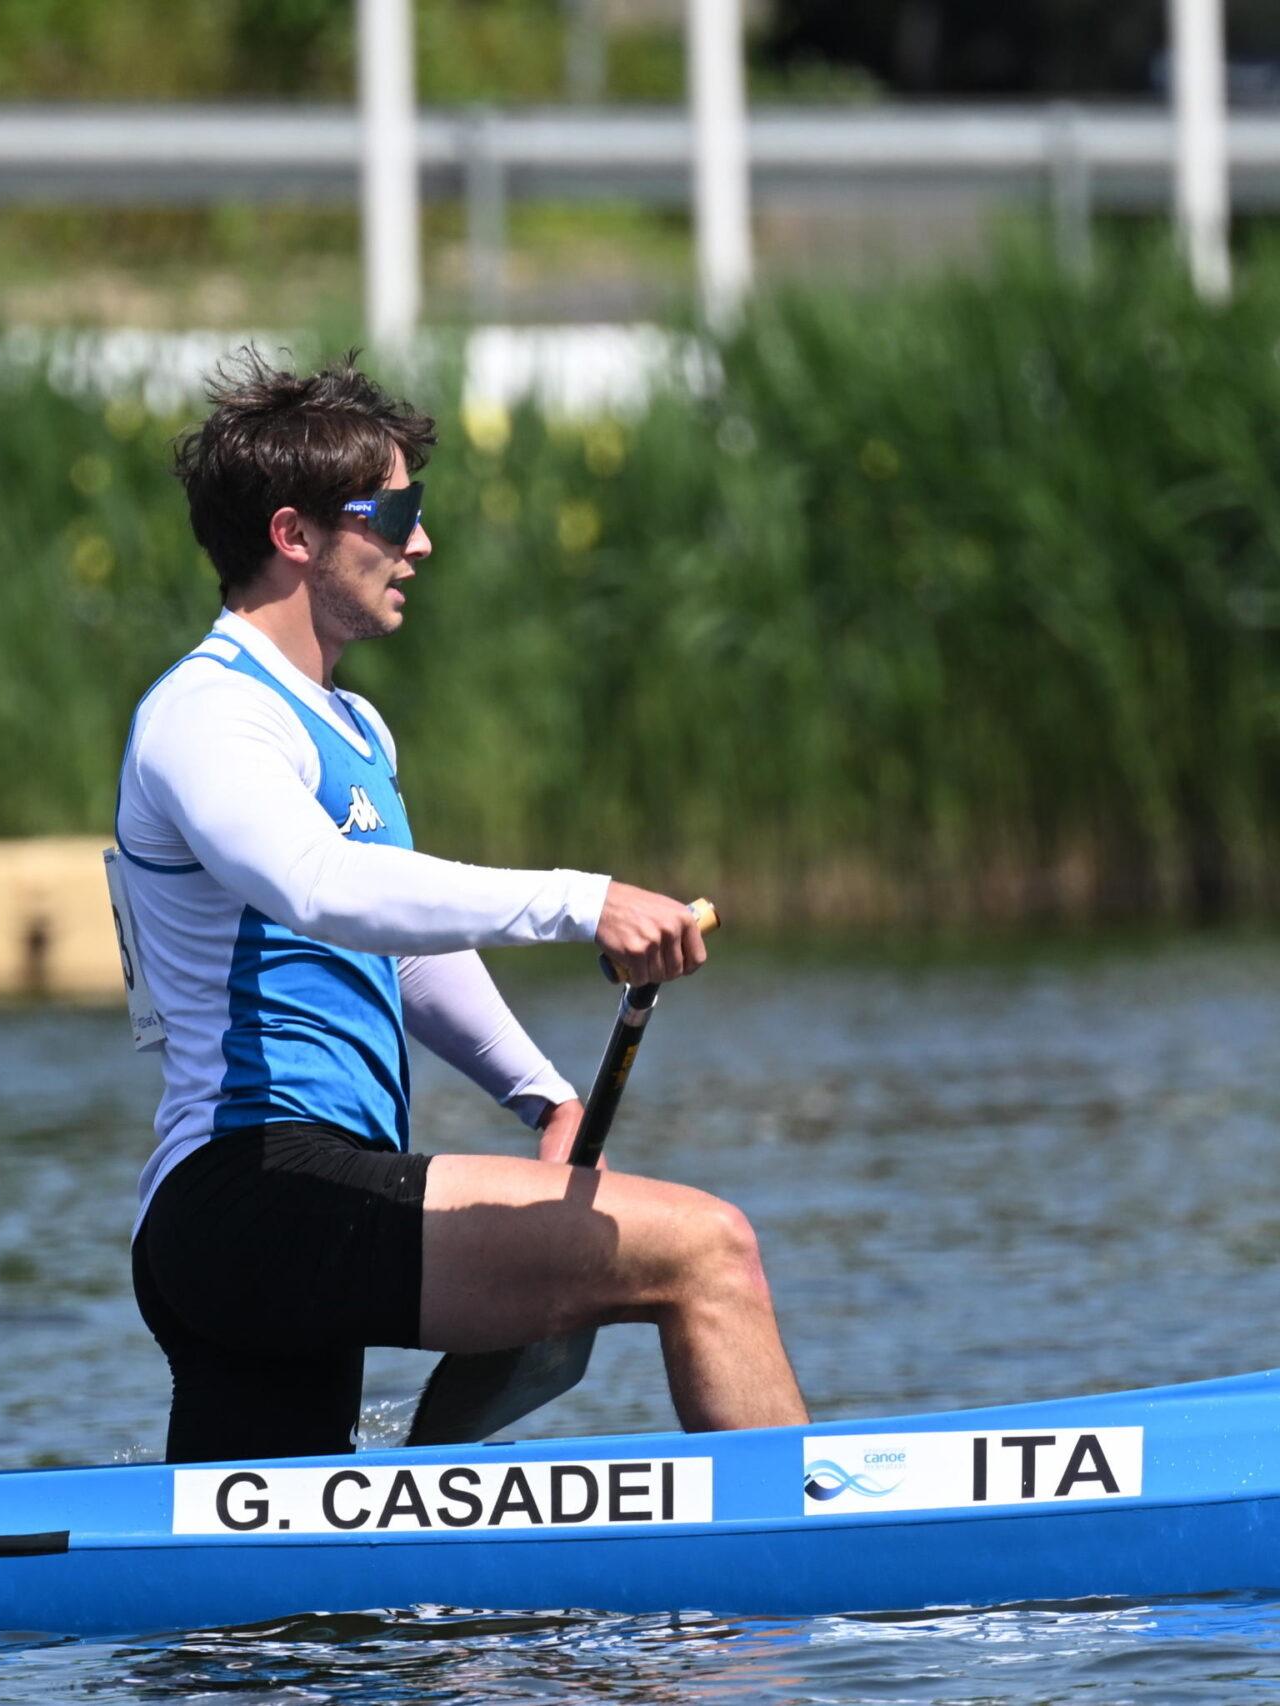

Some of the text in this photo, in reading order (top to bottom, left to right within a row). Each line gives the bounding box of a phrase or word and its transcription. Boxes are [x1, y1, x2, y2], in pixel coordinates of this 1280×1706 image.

[863, 1452, 907, 1464] canoe
[972, 1434, 1121, 1502] ITA
[214, 1461, 675, 1532] G. CASADEI
